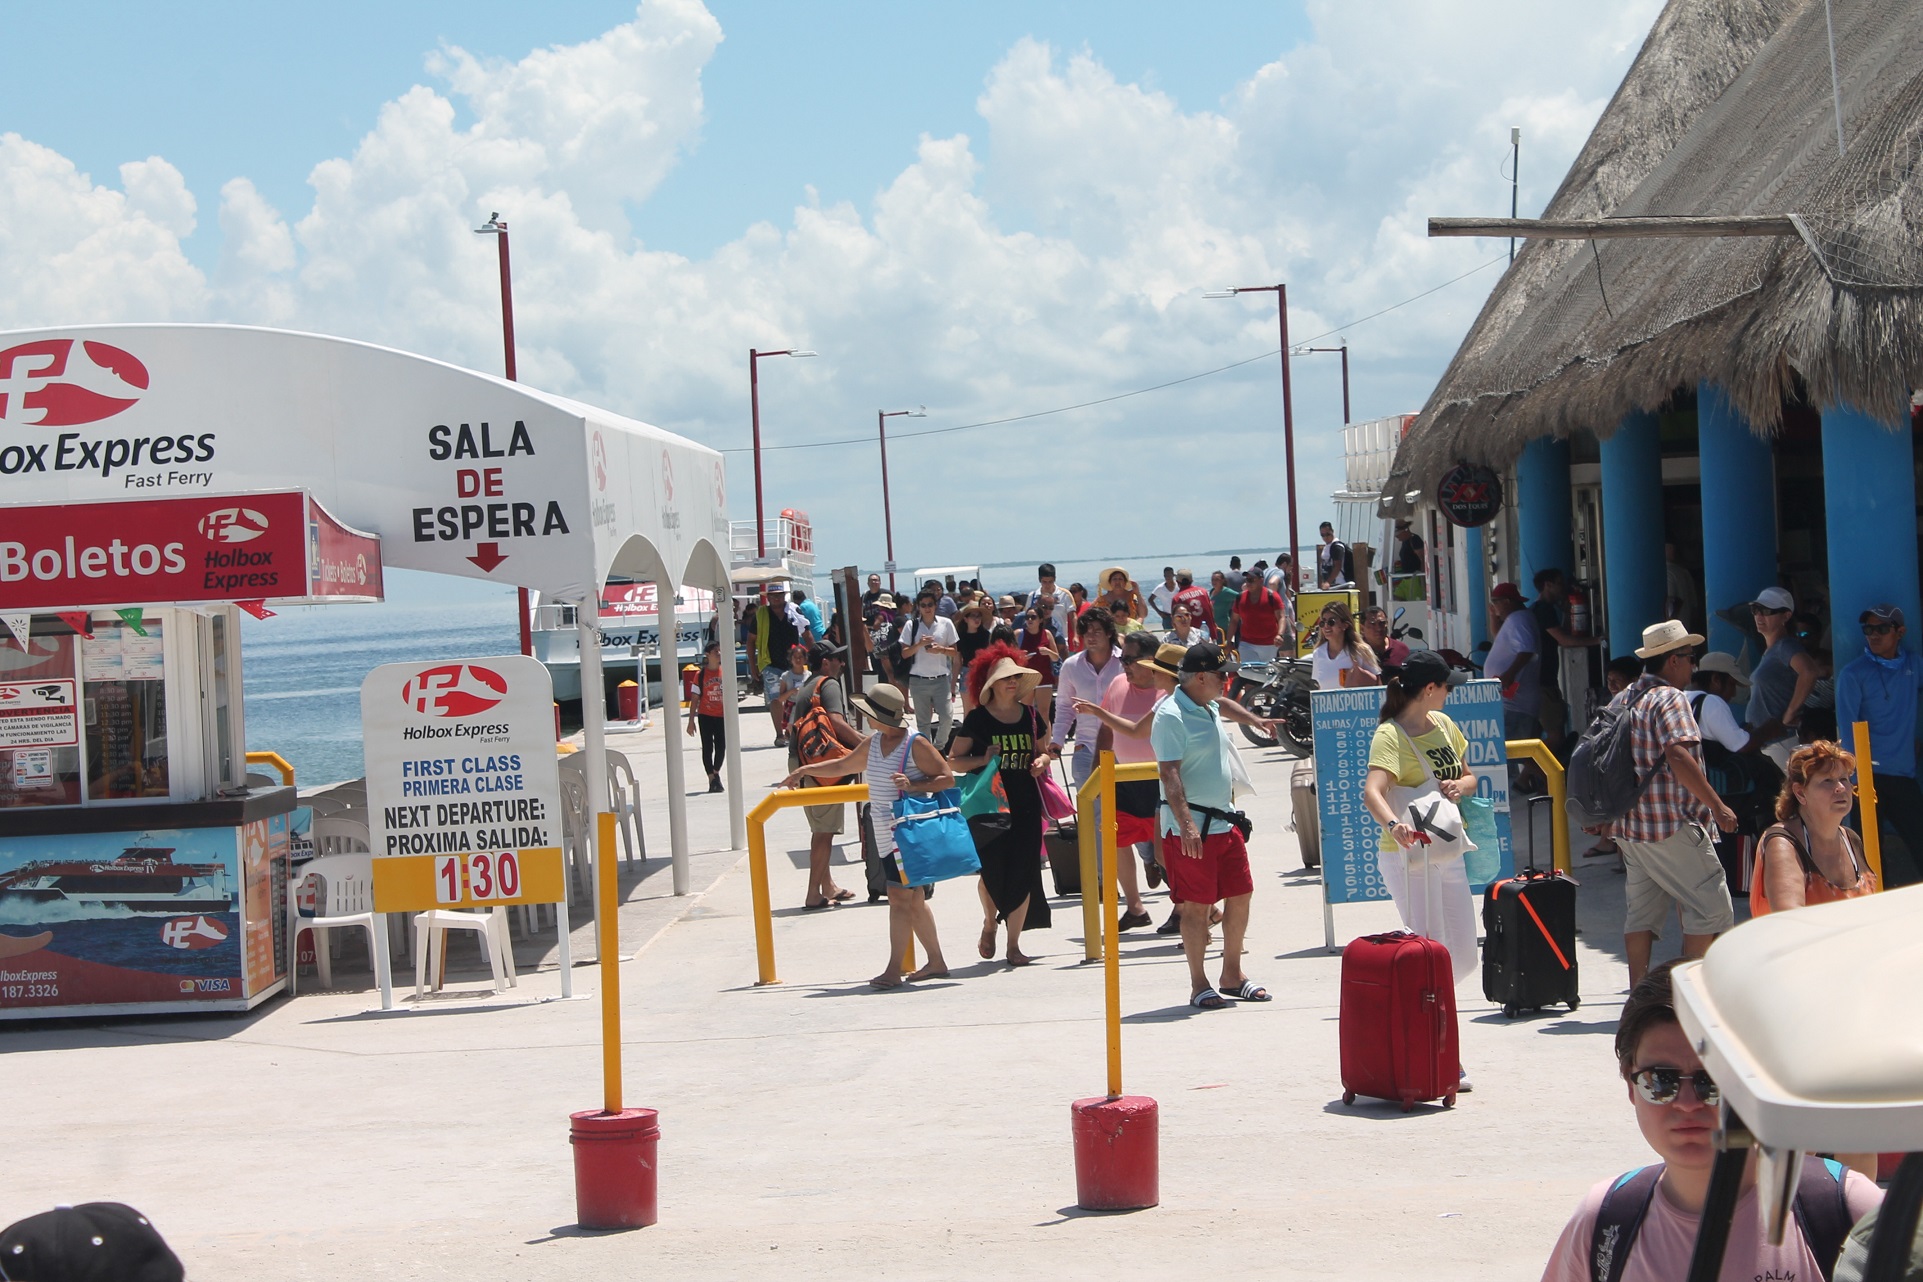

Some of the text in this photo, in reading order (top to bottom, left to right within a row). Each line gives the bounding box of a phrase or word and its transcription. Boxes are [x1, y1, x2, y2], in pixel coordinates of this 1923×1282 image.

[429, 420, 535, 461] SALA
[54, 433, 216, 478] Express
[125, 471, 213, 489] Fast Ferry
[456, 467, 504, 498] DE
[412, 500, 570, 542] ESPERA
[0, 535, 187, 583] Boletos
[204, 548, 273, 569] Holbox
[203, 569, 279, 593] Express
[614, 603, 648, 612] Holbox
[1189, 599, 1204, 617] 3
[1312, 691, 1376, 714] TRANSPORTE
[402, 722, 509, 740] Holbox Express
[480, 735, 510, 744] Fast Ferry
[992, 733, 1032, 751] NEVER
[403, 754, 522, 778] FIRST CLASS
[403, 774, 524, 798] PRIMERA CLASE
[1493, 793, 1507, 803] PM
[384, 798, 546, 830] NEXT DEPARTURE:
[386, 826, 549, 856] PROXIMA SALIDA:
[145, 864, 157, 874] IV
[440, 851, 519, 902] 1:30
[1, 985, 59, 999] 187.3326
[195, 978, 231, 992] VISA
